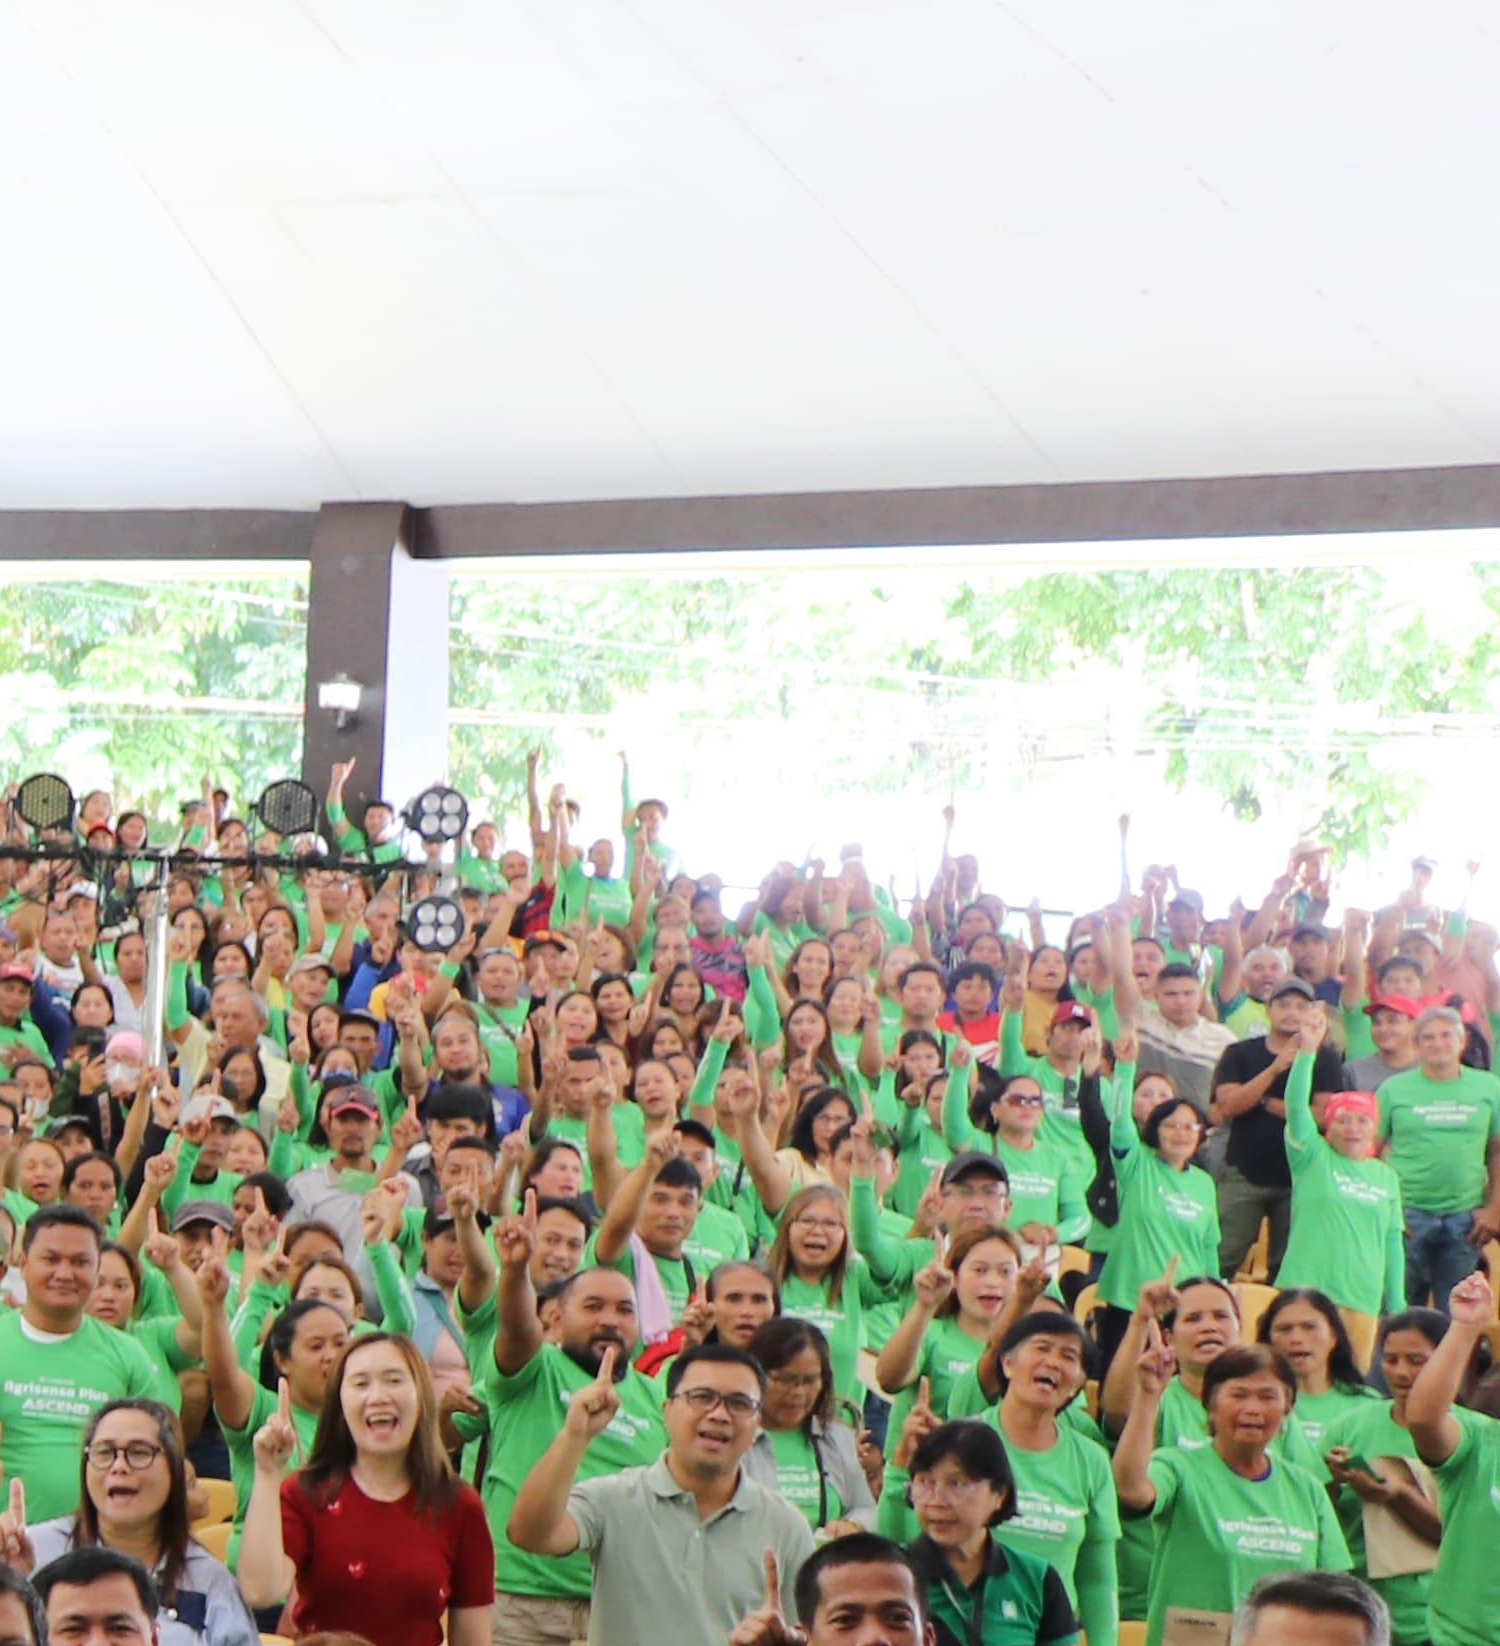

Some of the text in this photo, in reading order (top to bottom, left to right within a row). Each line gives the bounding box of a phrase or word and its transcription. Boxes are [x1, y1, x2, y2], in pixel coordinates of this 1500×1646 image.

[4, 1379, 109, 1402] Agrisenso Plus
[22, 1398, 90, 1416] ASCEND
[1237, 1536, 1303, 1554] ASCEND
